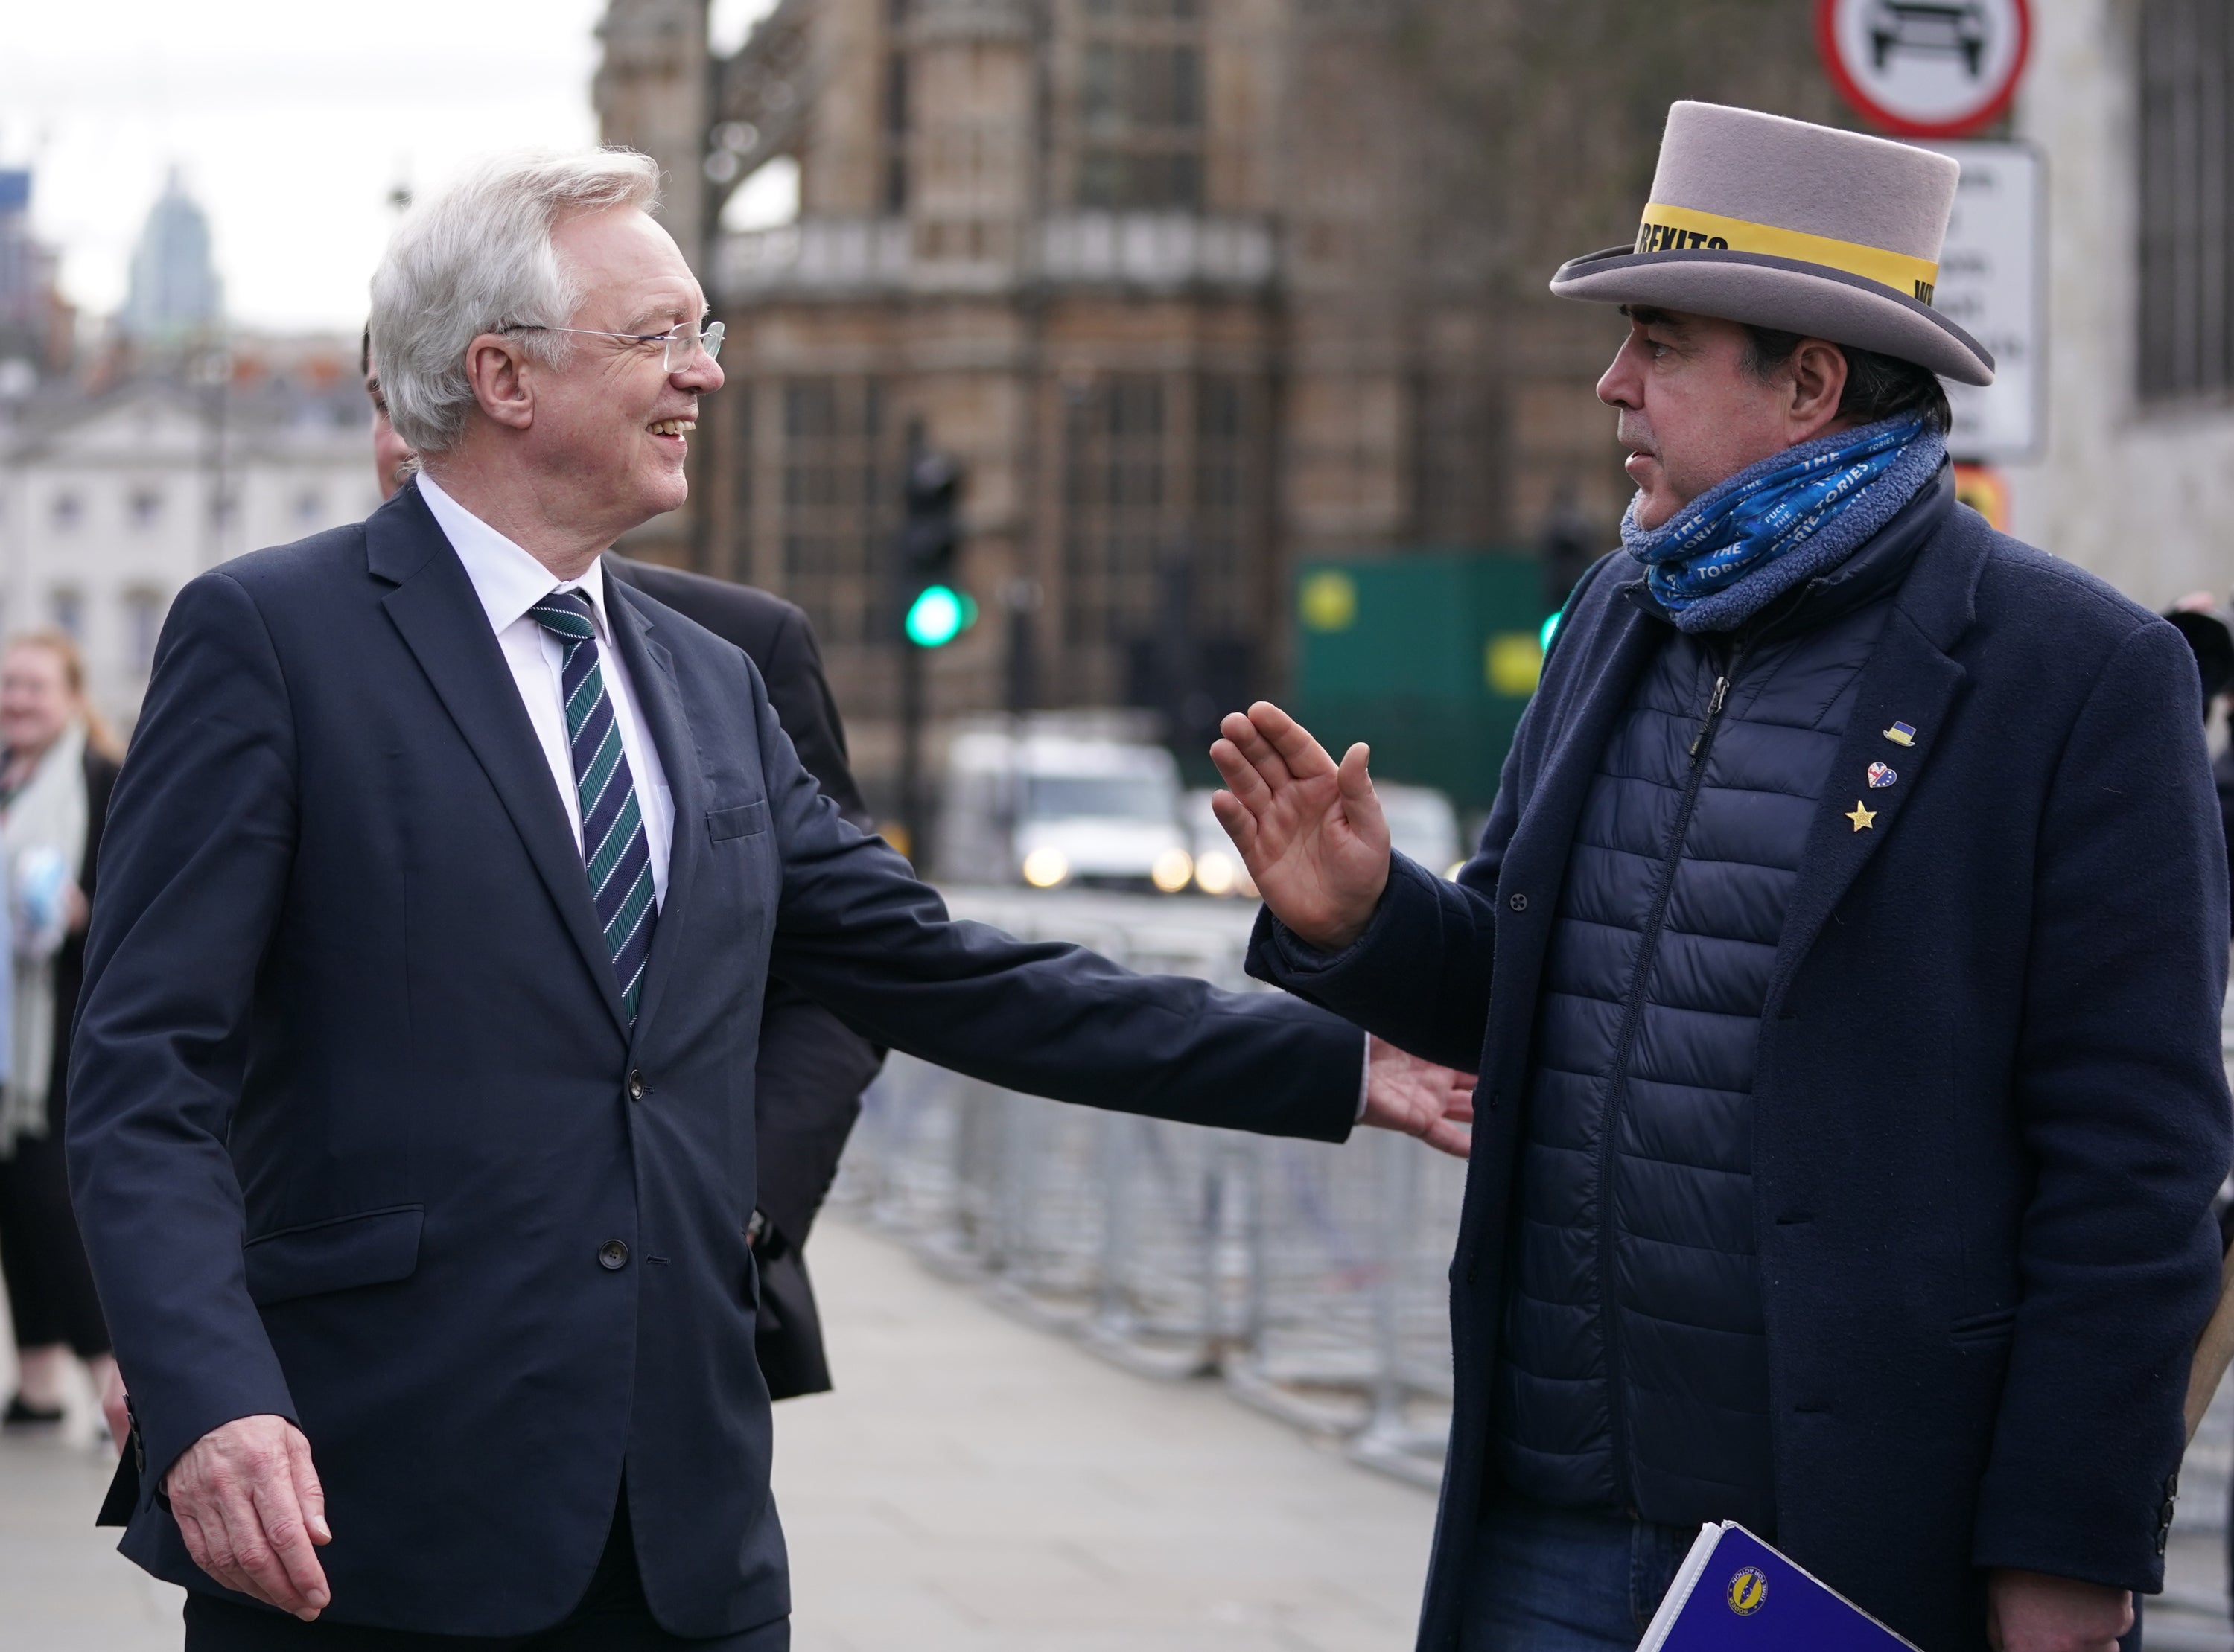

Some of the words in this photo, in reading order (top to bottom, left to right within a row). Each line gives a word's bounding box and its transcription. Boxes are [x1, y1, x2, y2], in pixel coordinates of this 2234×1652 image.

[1868, 436, 1895, 452] TORIES
[1764, 502, 1788, 524] FUCK
[1773, 511, 1792, 529] THE
[1731, 1568, 1754, 1584] ACTION
